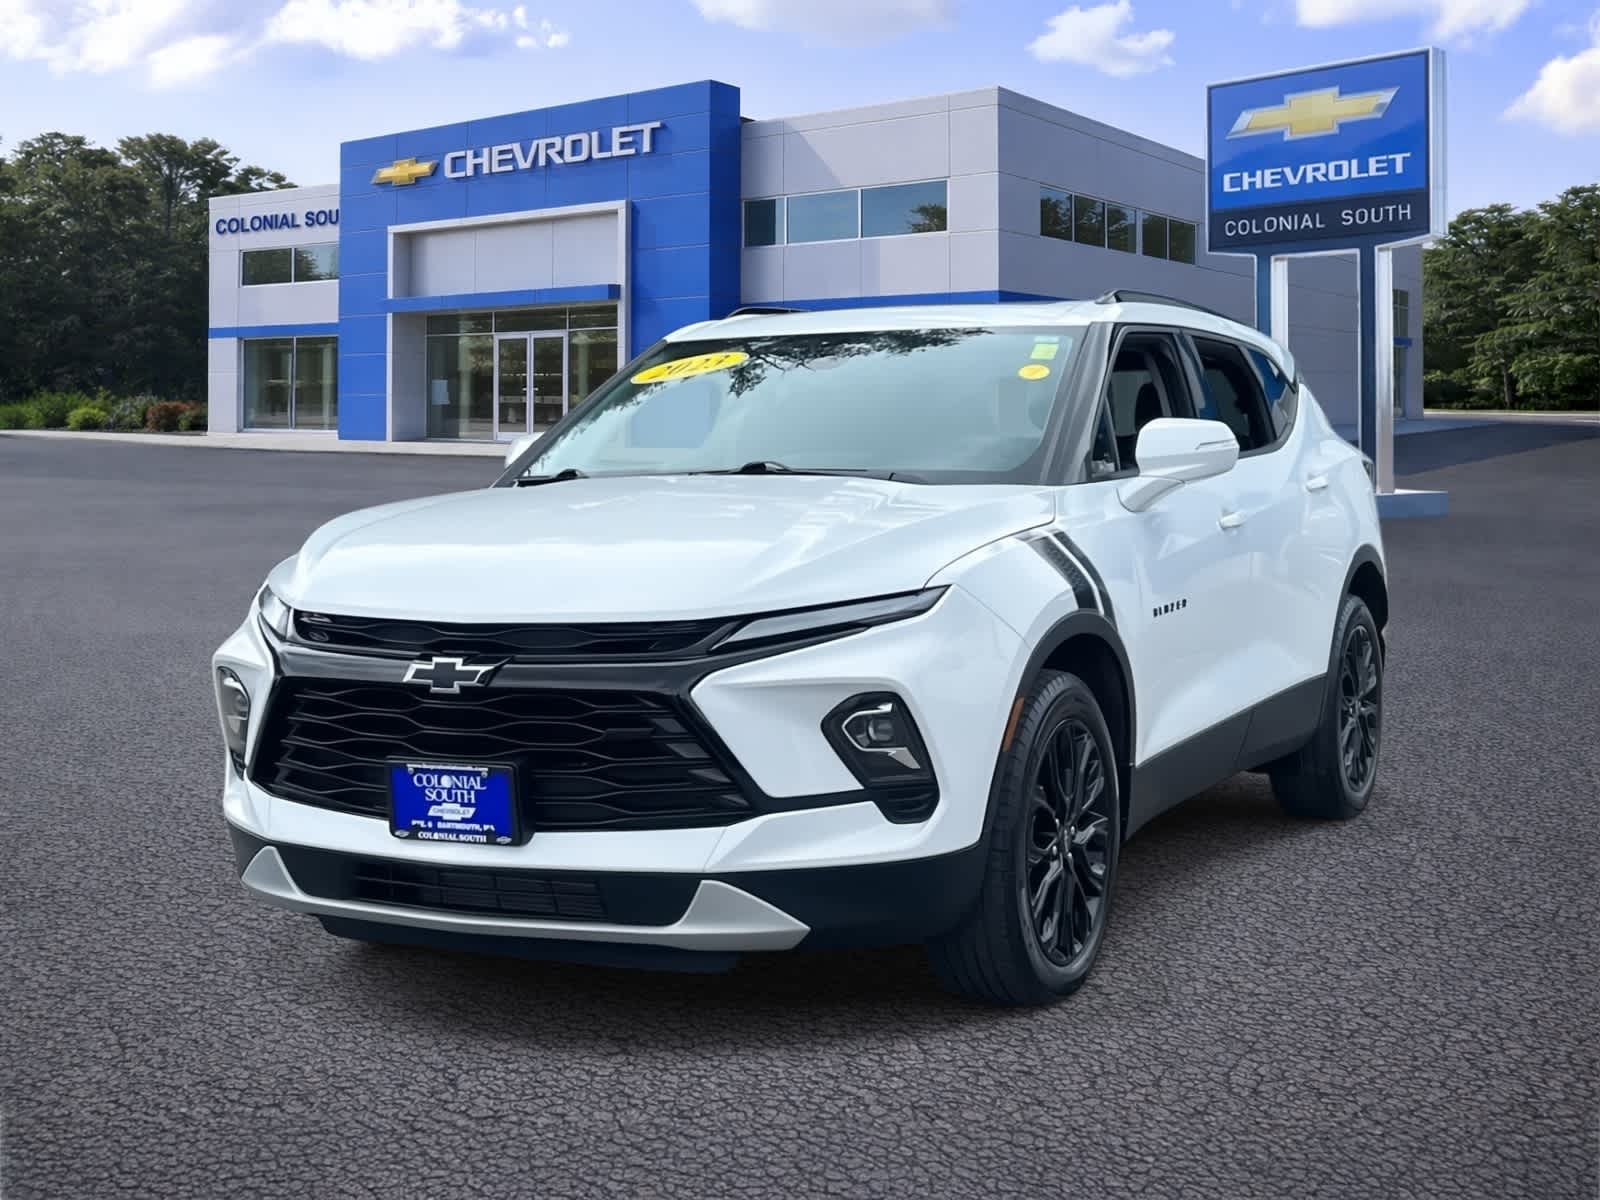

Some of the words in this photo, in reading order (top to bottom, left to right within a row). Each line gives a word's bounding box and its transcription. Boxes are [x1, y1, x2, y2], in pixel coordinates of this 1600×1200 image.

[443, 121, 662, 179] CHEVROLET
[1223, 152, 1411, 193] CHEVROLET
[215, 212, 301, 235] COLONIAL
[1224, 212, 1326, 237] COLONIAL
[1341, 203, 1412, 227] SOUTH
[413, 772, 487, 790] COLONIAL
[425, 787, 476, 803] SOUTH
[418, 831, 459, 840] COLONIAL
[459, 834, 487, 843] SOUTH
